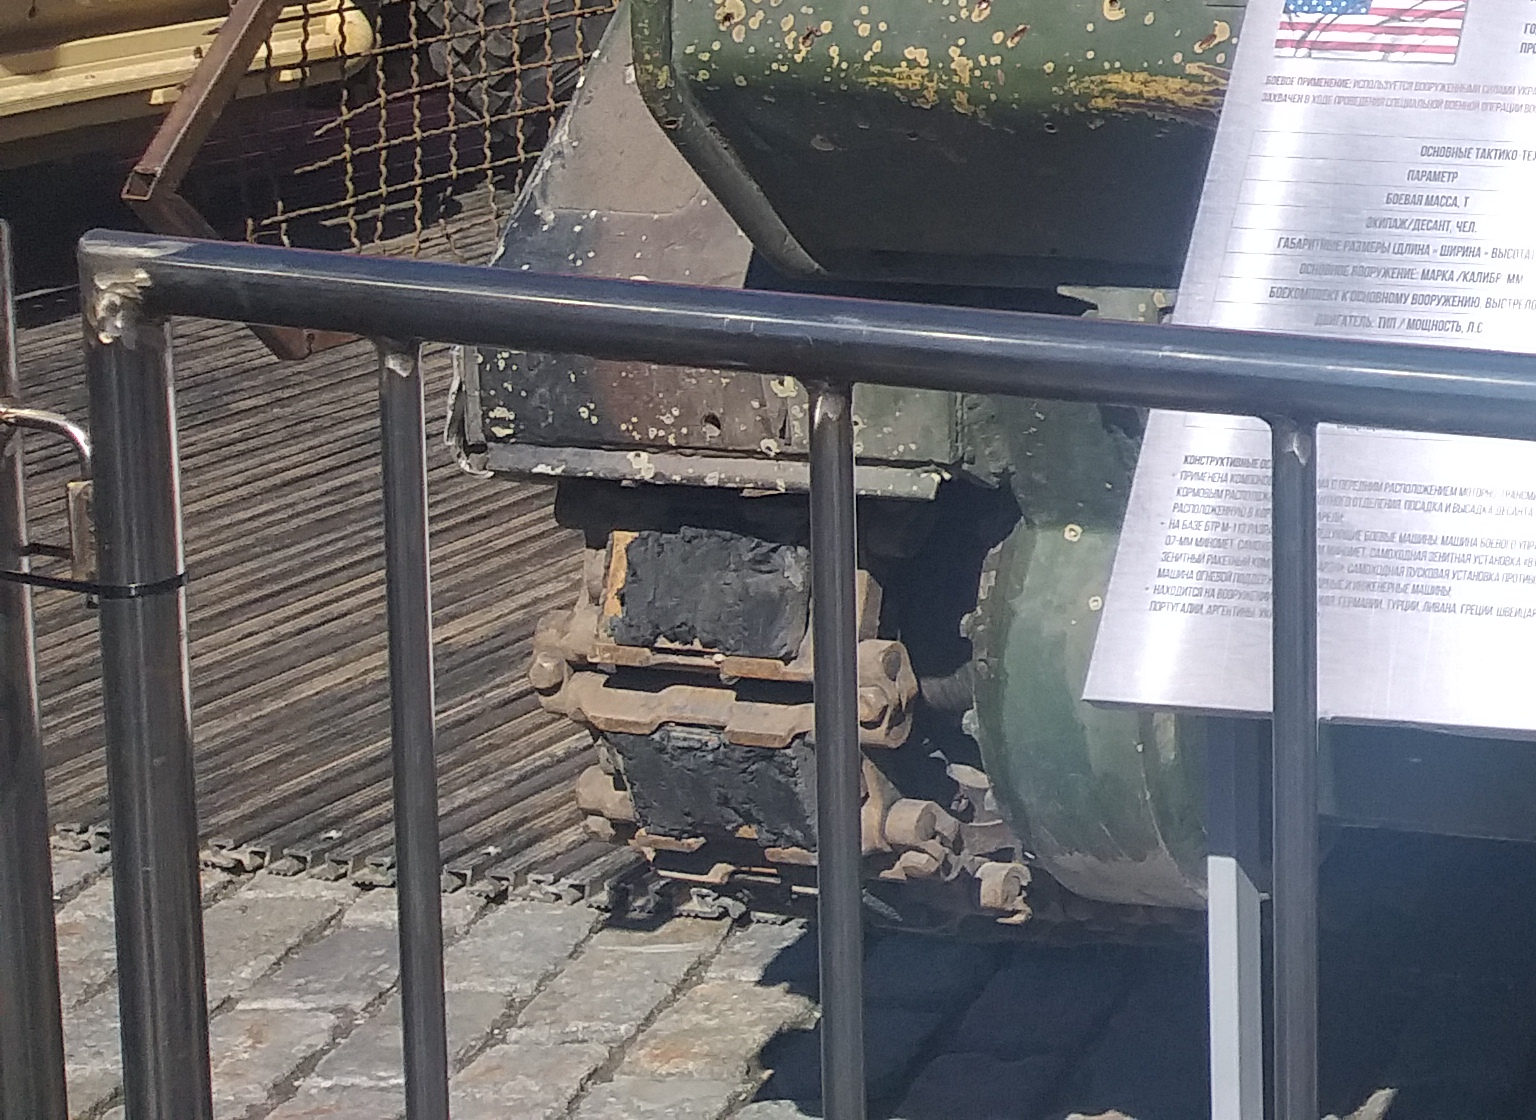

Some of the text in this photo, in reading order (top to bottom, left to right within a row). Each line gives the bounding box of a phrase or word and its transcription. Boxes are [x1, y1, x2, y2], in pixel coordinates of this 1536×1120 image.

[1264, 74, 1295, 86] БОЕВОЕ
[1352, 78, 1414, 91] ИСПОЛЬЗУЕТСЯ
[1413, 80, 1482, 94] ВООРУЖЕННЫМИ
[1303, 94, 1312, 105] В
[1310, 94, 1334, 106] ХОДЕ
[1418, 144, 1473, 159] ОСНОВНЫЕ
[1405, 168, 1459, 183] ПАРАМЕТР
[1384, 192, 1471, 208] БОЕВАЯ МАССА, Т
[1363, 216, 1479, 234] ЭКИПАЖ/ДЕСАНТ, ЧЕЛ.
[1275, 236, 1342, 252] ГАБАРИТНЫЕ
[1341, 239, 1392, 254] РАЗМЕРЫ
[1438, 244, 1483, 259] ШИРИНА
[1297, 262, 1351, 277] ОСНОВНОЕ
[1419, 268, 1456, 282] МАРКА
[1267, 285, 1340, 301] БОЕКОМПЛЕКТ
[1340, 289, 1350, 302] К
[1348, 289, 1410, 305] ОСНОВНОМУ
[1376, 316, 1398, 330] ТИП
[1405, 317, 1466, 333] МОЩНОСТЬ,
[1182, 454, 1259, 469] КОНСТРУКТИВНЫЕ
[1178, 470, 1229, 483] ПРИМЕНЕНА
[1175, 486, 1224, 500] КОРМОВЫМ
[1382, 481, 1458, 497] РАСПОЛОЖЕНИЕМ
[1171, 502, 1246, 517] РАСПОЛОЖЕННУЮ
[1402, 499, 1444, 513] ПОСАДКА
[1443, 501, 1452, 513] И
[1167, 518, 1181, 530] НА
[1180, 519, 1204, 531] БАЗЕ
[1203, 520, 1221, 532] БТР
[1362, 529, 1396, 543] БОЕВЫЕ
[1440, 534, 1479, 548] МАШИНА
[1159, 550, 1206, 564] ЗЕНИТНЫЙ
[1368, 546, 1428, 561] САМОХОДНАЯ
[1426, 550, 1472, 564] ЗЕНИТНАЯ
[1471, 552, 1522, 567] УСТАНОВКА
[1156, 567, 1195, 580] МАШИНА
[1346, 561, 1405, 577] САМОХОДНАЯ
[1404, 565, 1451, 580] ПУСКОВАЯ
[1450, 568, 1501, 583] УСТАНОВКА
[1151, 583, 1204, 598] НАХОДИТСЯ
[1202, 587, 1217, 599] НА
